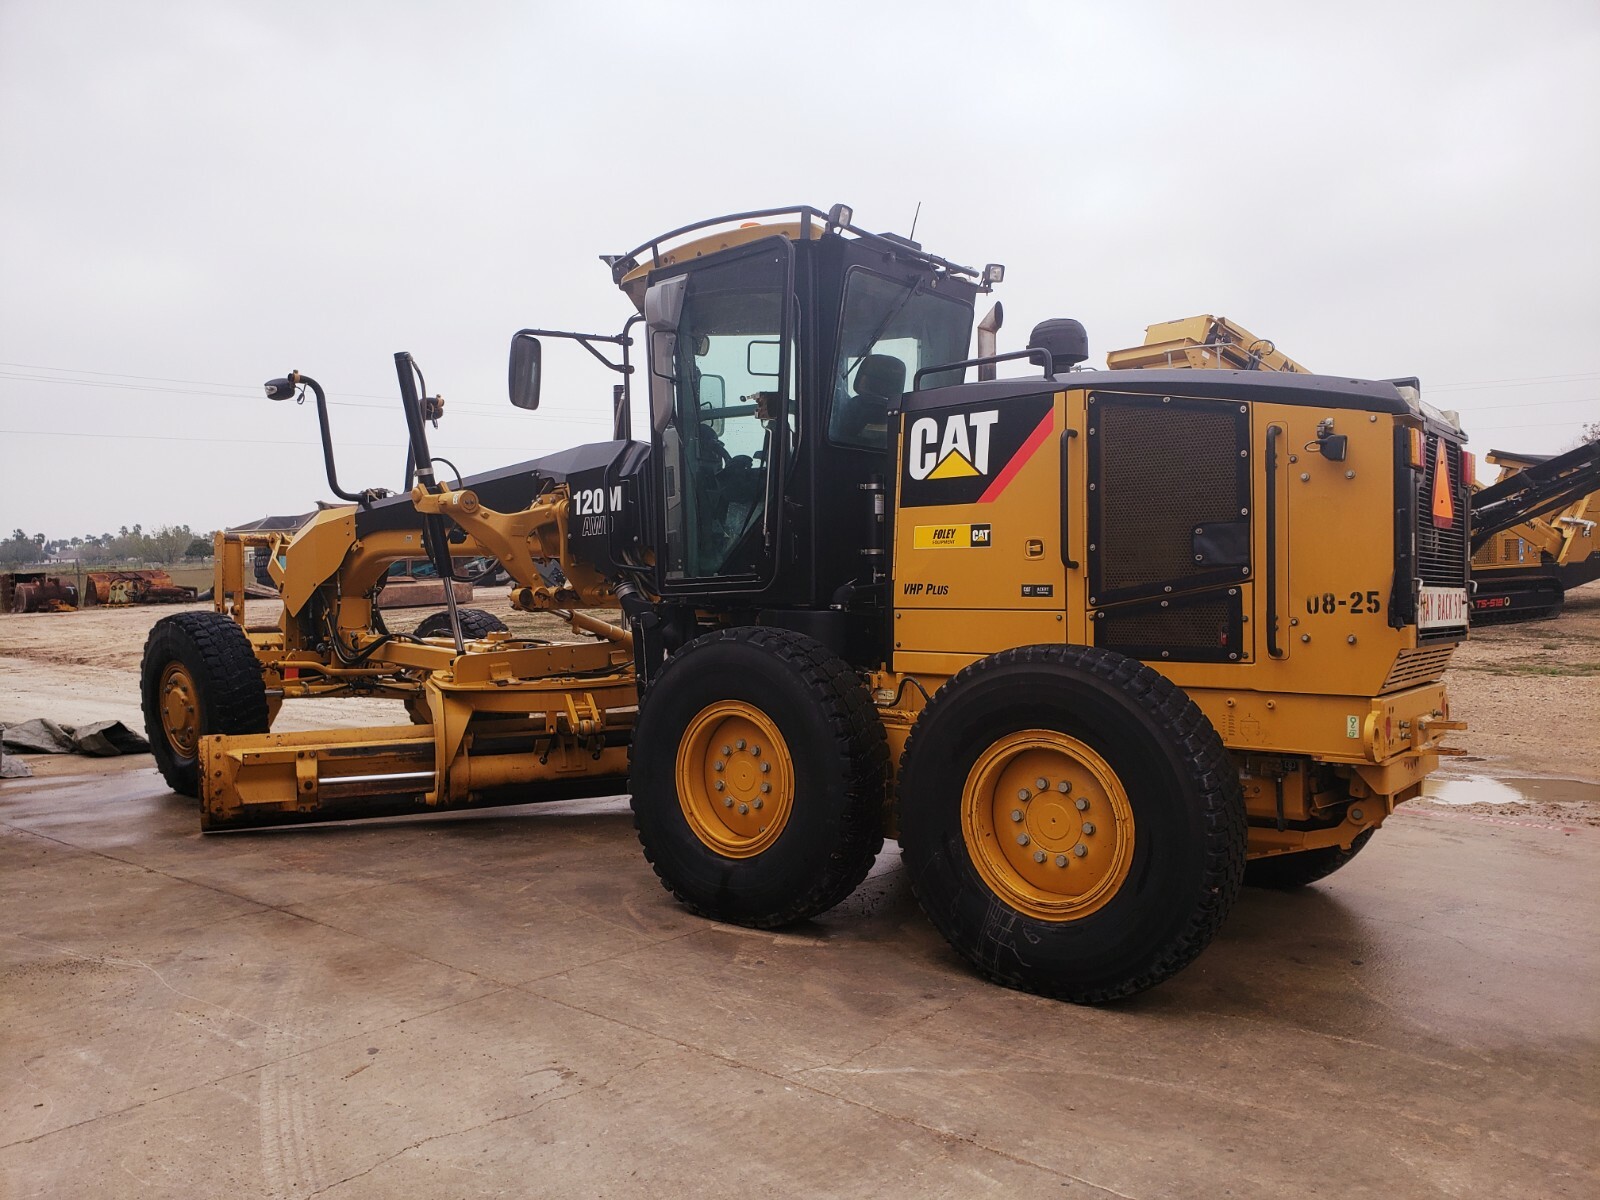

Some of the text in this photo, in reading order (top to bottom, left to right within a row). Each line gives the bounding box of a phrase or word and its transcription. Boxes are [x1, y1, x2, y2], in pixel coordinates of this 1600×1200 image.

[909, 410, 999, 481] CAT
[933, 528, 957, 540] FOLEY
[972, 529, 990, 542] CAT
[903, 583, 923, 596] VHP
[1306, 591, 1380, 615] 08-25
[1437, 593, 1453, 620] BACK
